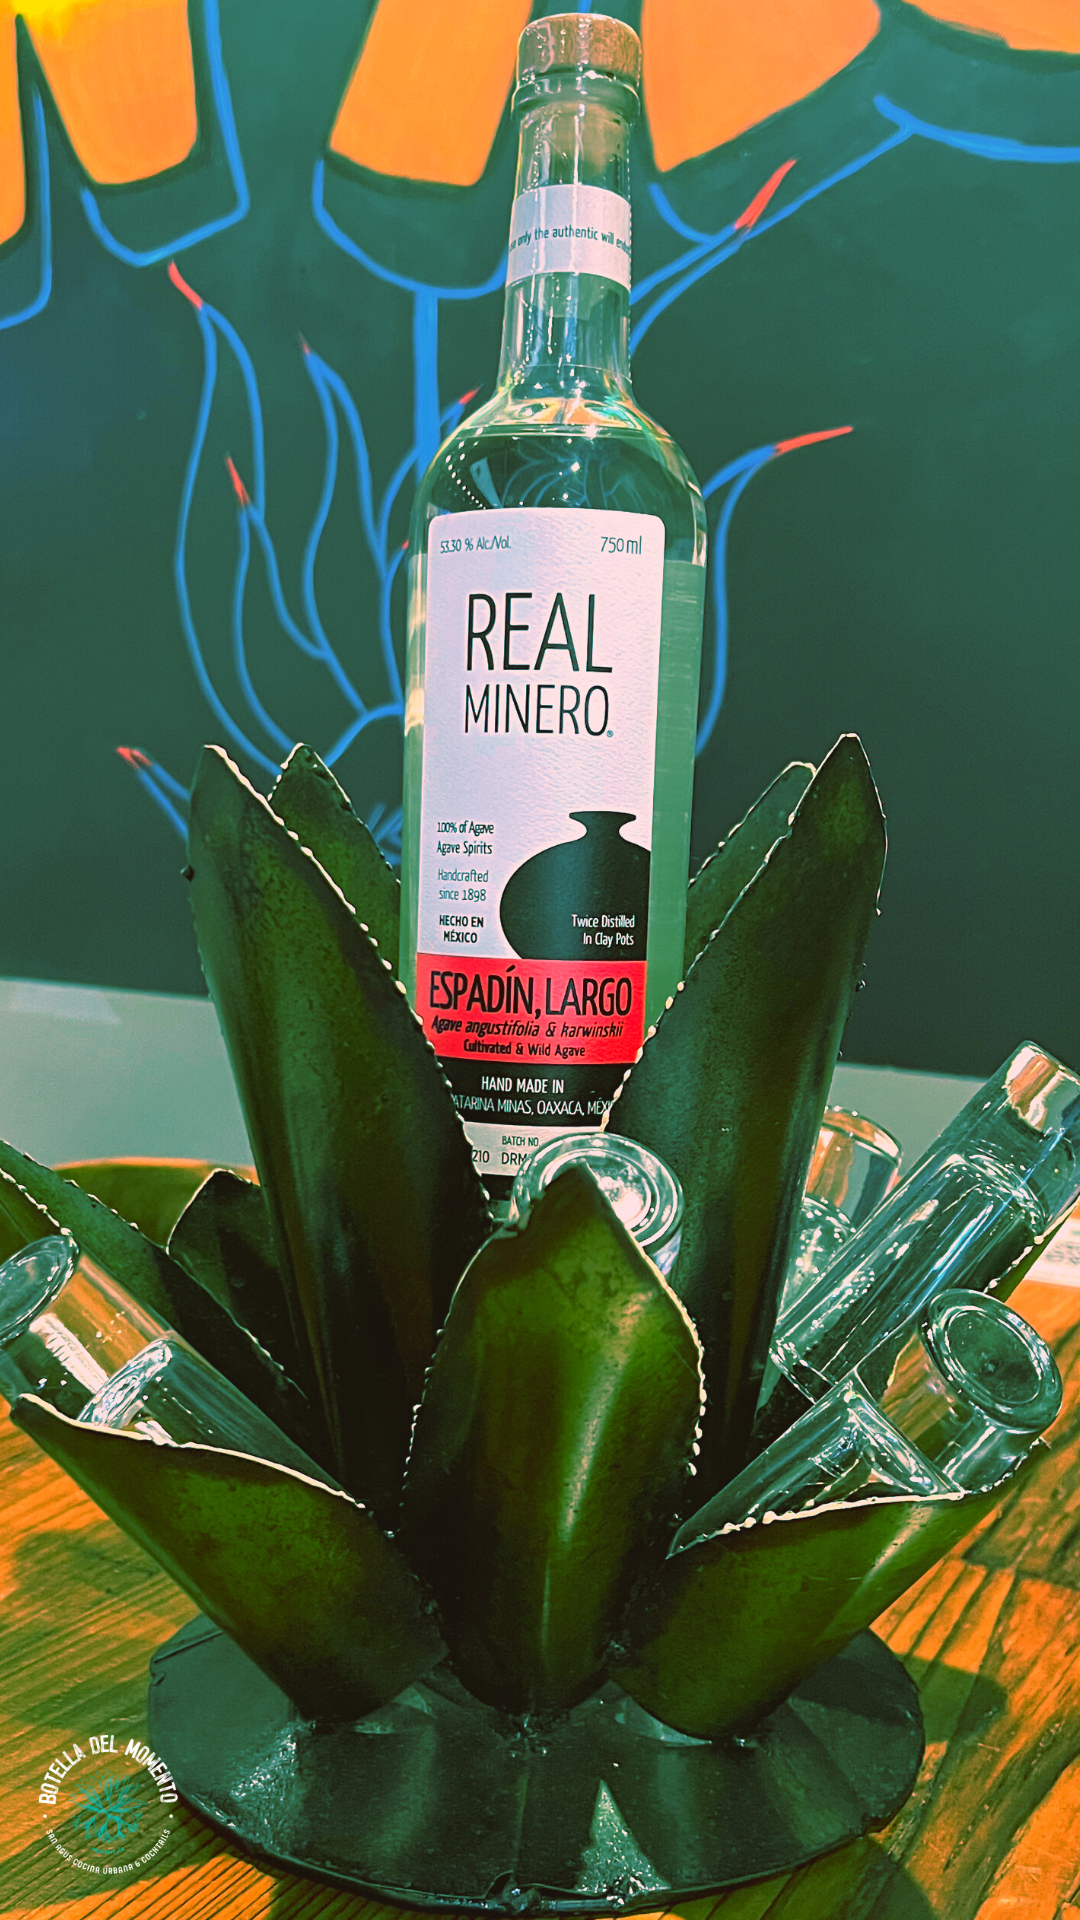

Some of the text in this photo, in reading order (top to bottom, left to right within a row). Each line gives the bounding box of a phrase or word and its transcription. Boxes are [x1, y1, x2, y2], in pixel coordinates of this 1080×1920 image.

[534, 227, 549, 240] the
[553, 225, 598, 240] authentic
[601, 232, 614, 245] will
[465, 538, 473, 552] %
[467, 592, 613, 673] REAL
[437, 820, 494, 836] 100% of Agave
[437, 840, 492, 856] Agave Spirits
[438, 868, 489, 882] Handcrafted
[439, 887, 487, 902] since 1898
[439, 914, 484, 928] HECHO EN
[572, 914, 635, 928] Twice Distilled
[443, 929, 478, 943] MÉXICO
[583, 932, 634, 948] In Clay Pots
[545, 977, 632, 1016] LARGO
[431, 1015, 624, 1038] Agave angustifolia & karwinskii
[463, 1039, 586, 1060] Cultivated & Wild Agave
[481, 1076, 564, 1094] HAND MADE IN
[451, 1094, 495, 1112] ATARINA
[497, 1098, 534, 1116] MINAS,
[536, 1100, 585, 1116] OAXACA,
[501, 1135, 526, 1147] BATCH
[501, 1151, 528, 1166] DRM
